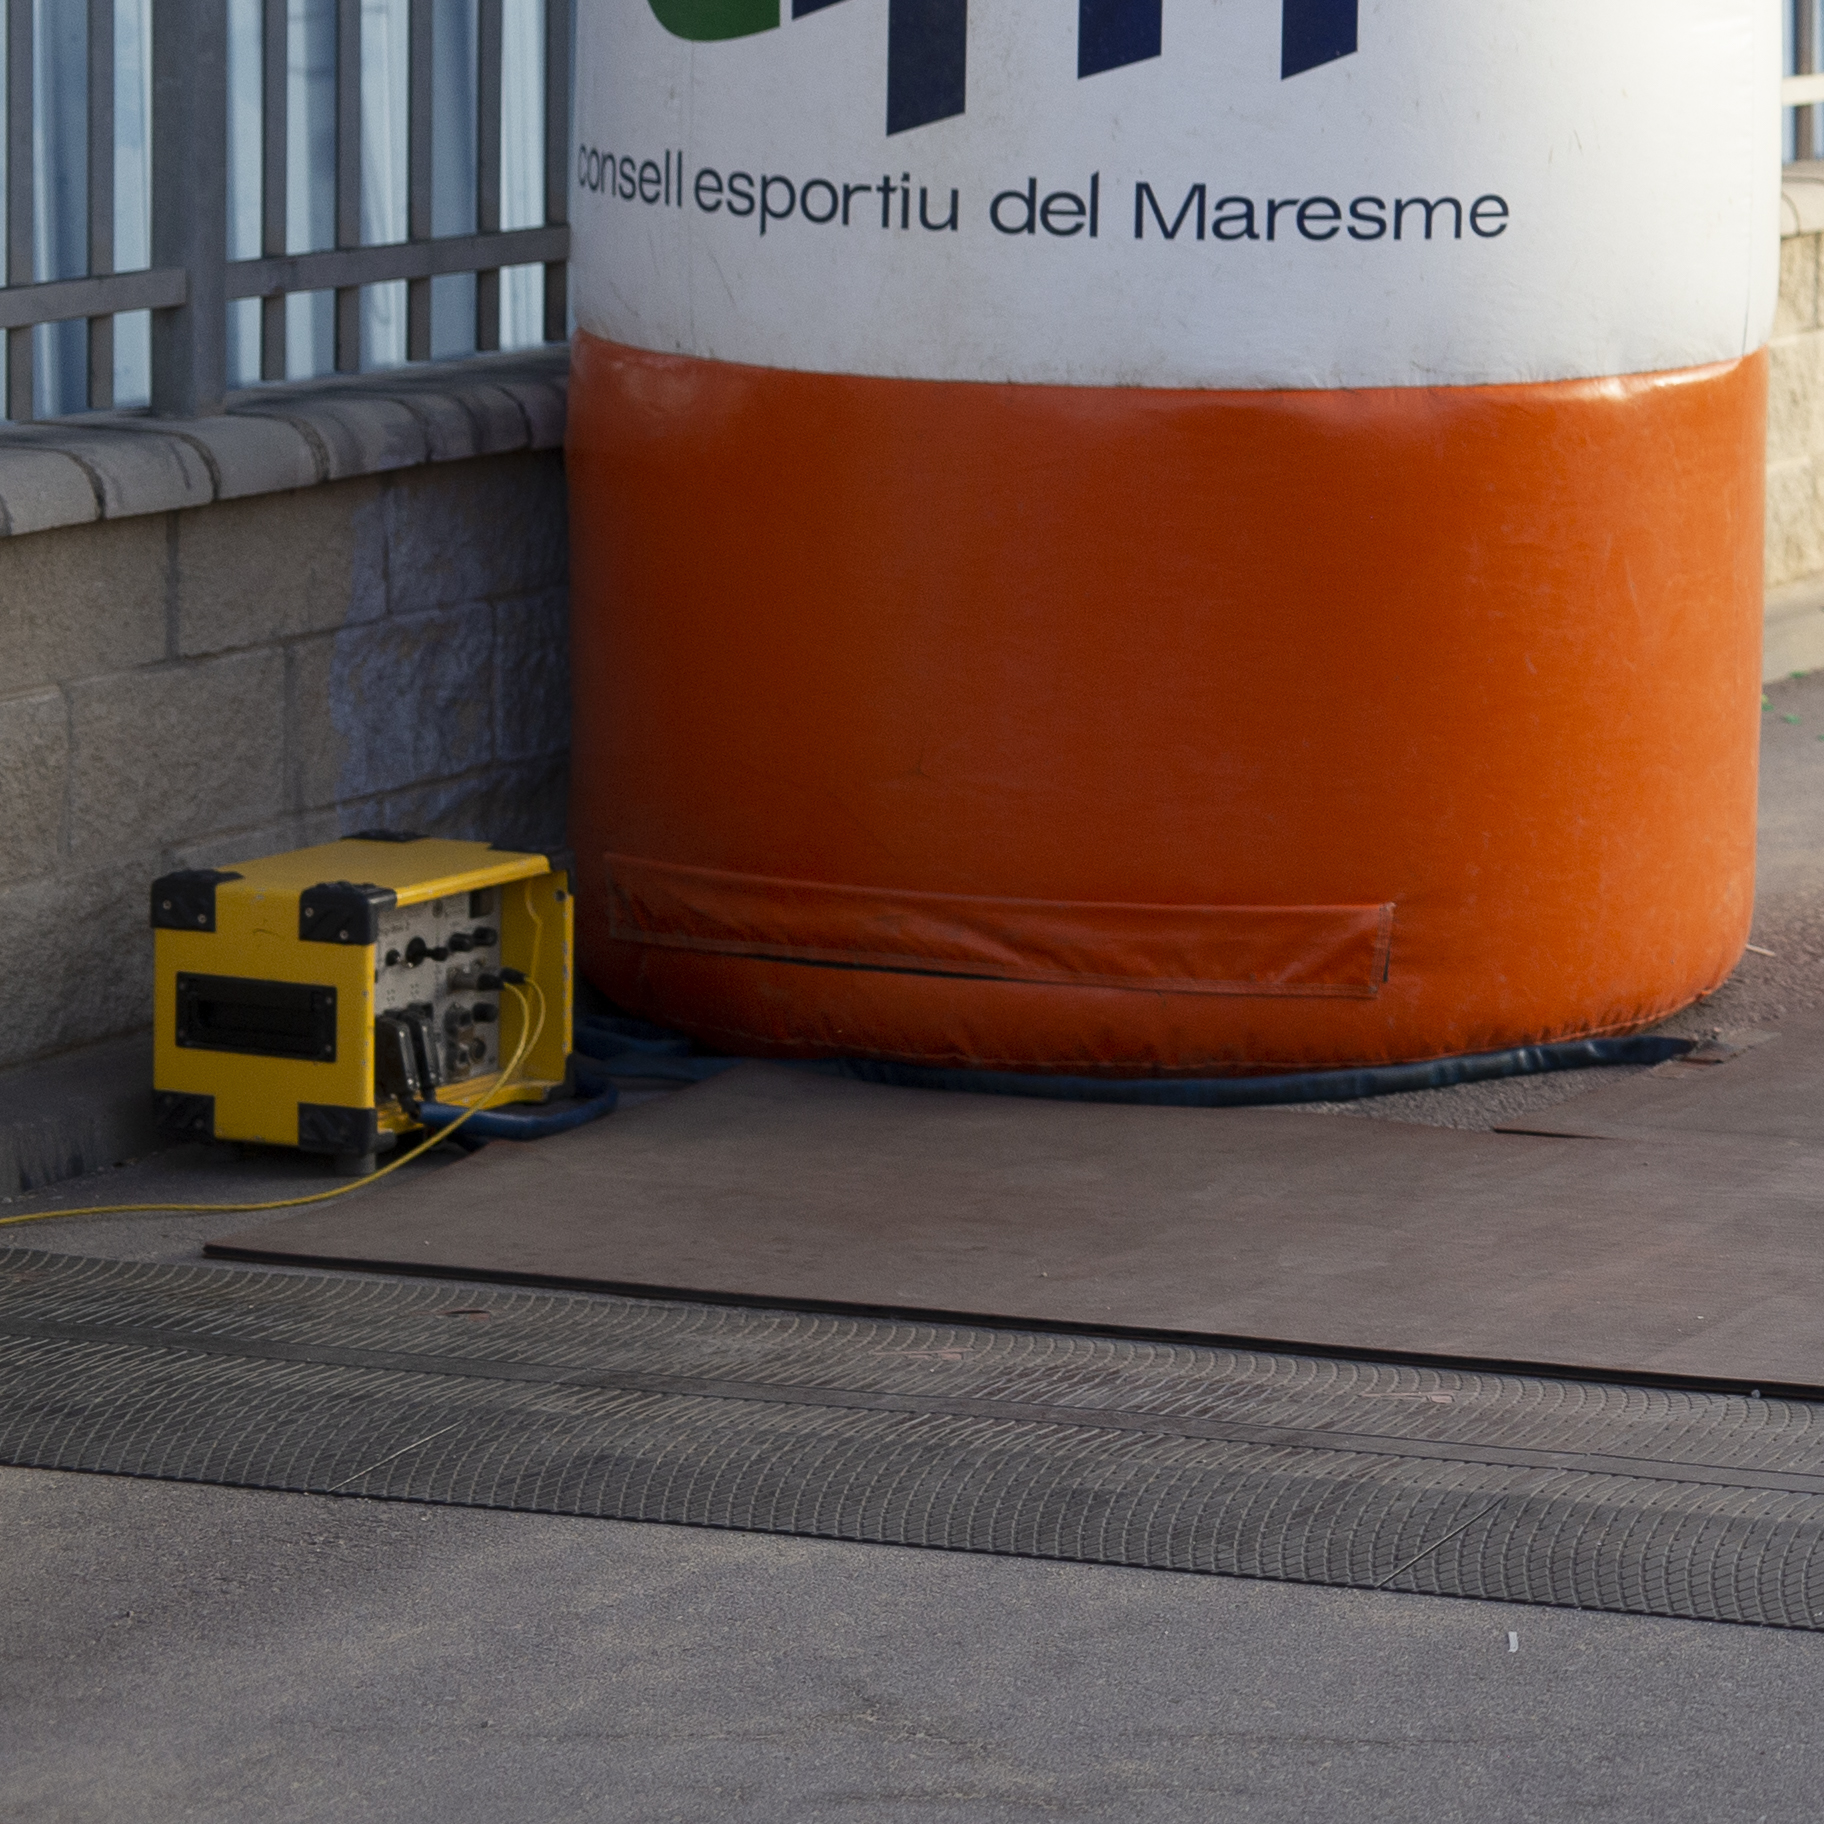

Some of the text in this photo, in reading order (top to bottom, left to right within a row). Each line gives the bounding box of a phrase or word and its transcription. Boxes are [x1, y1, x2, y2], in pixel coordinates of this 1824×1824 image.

[694, 168, 960, 236] esportiu
[989, 171, 1099, 238] del
[1133, 179, 1510, 241] Maresme
